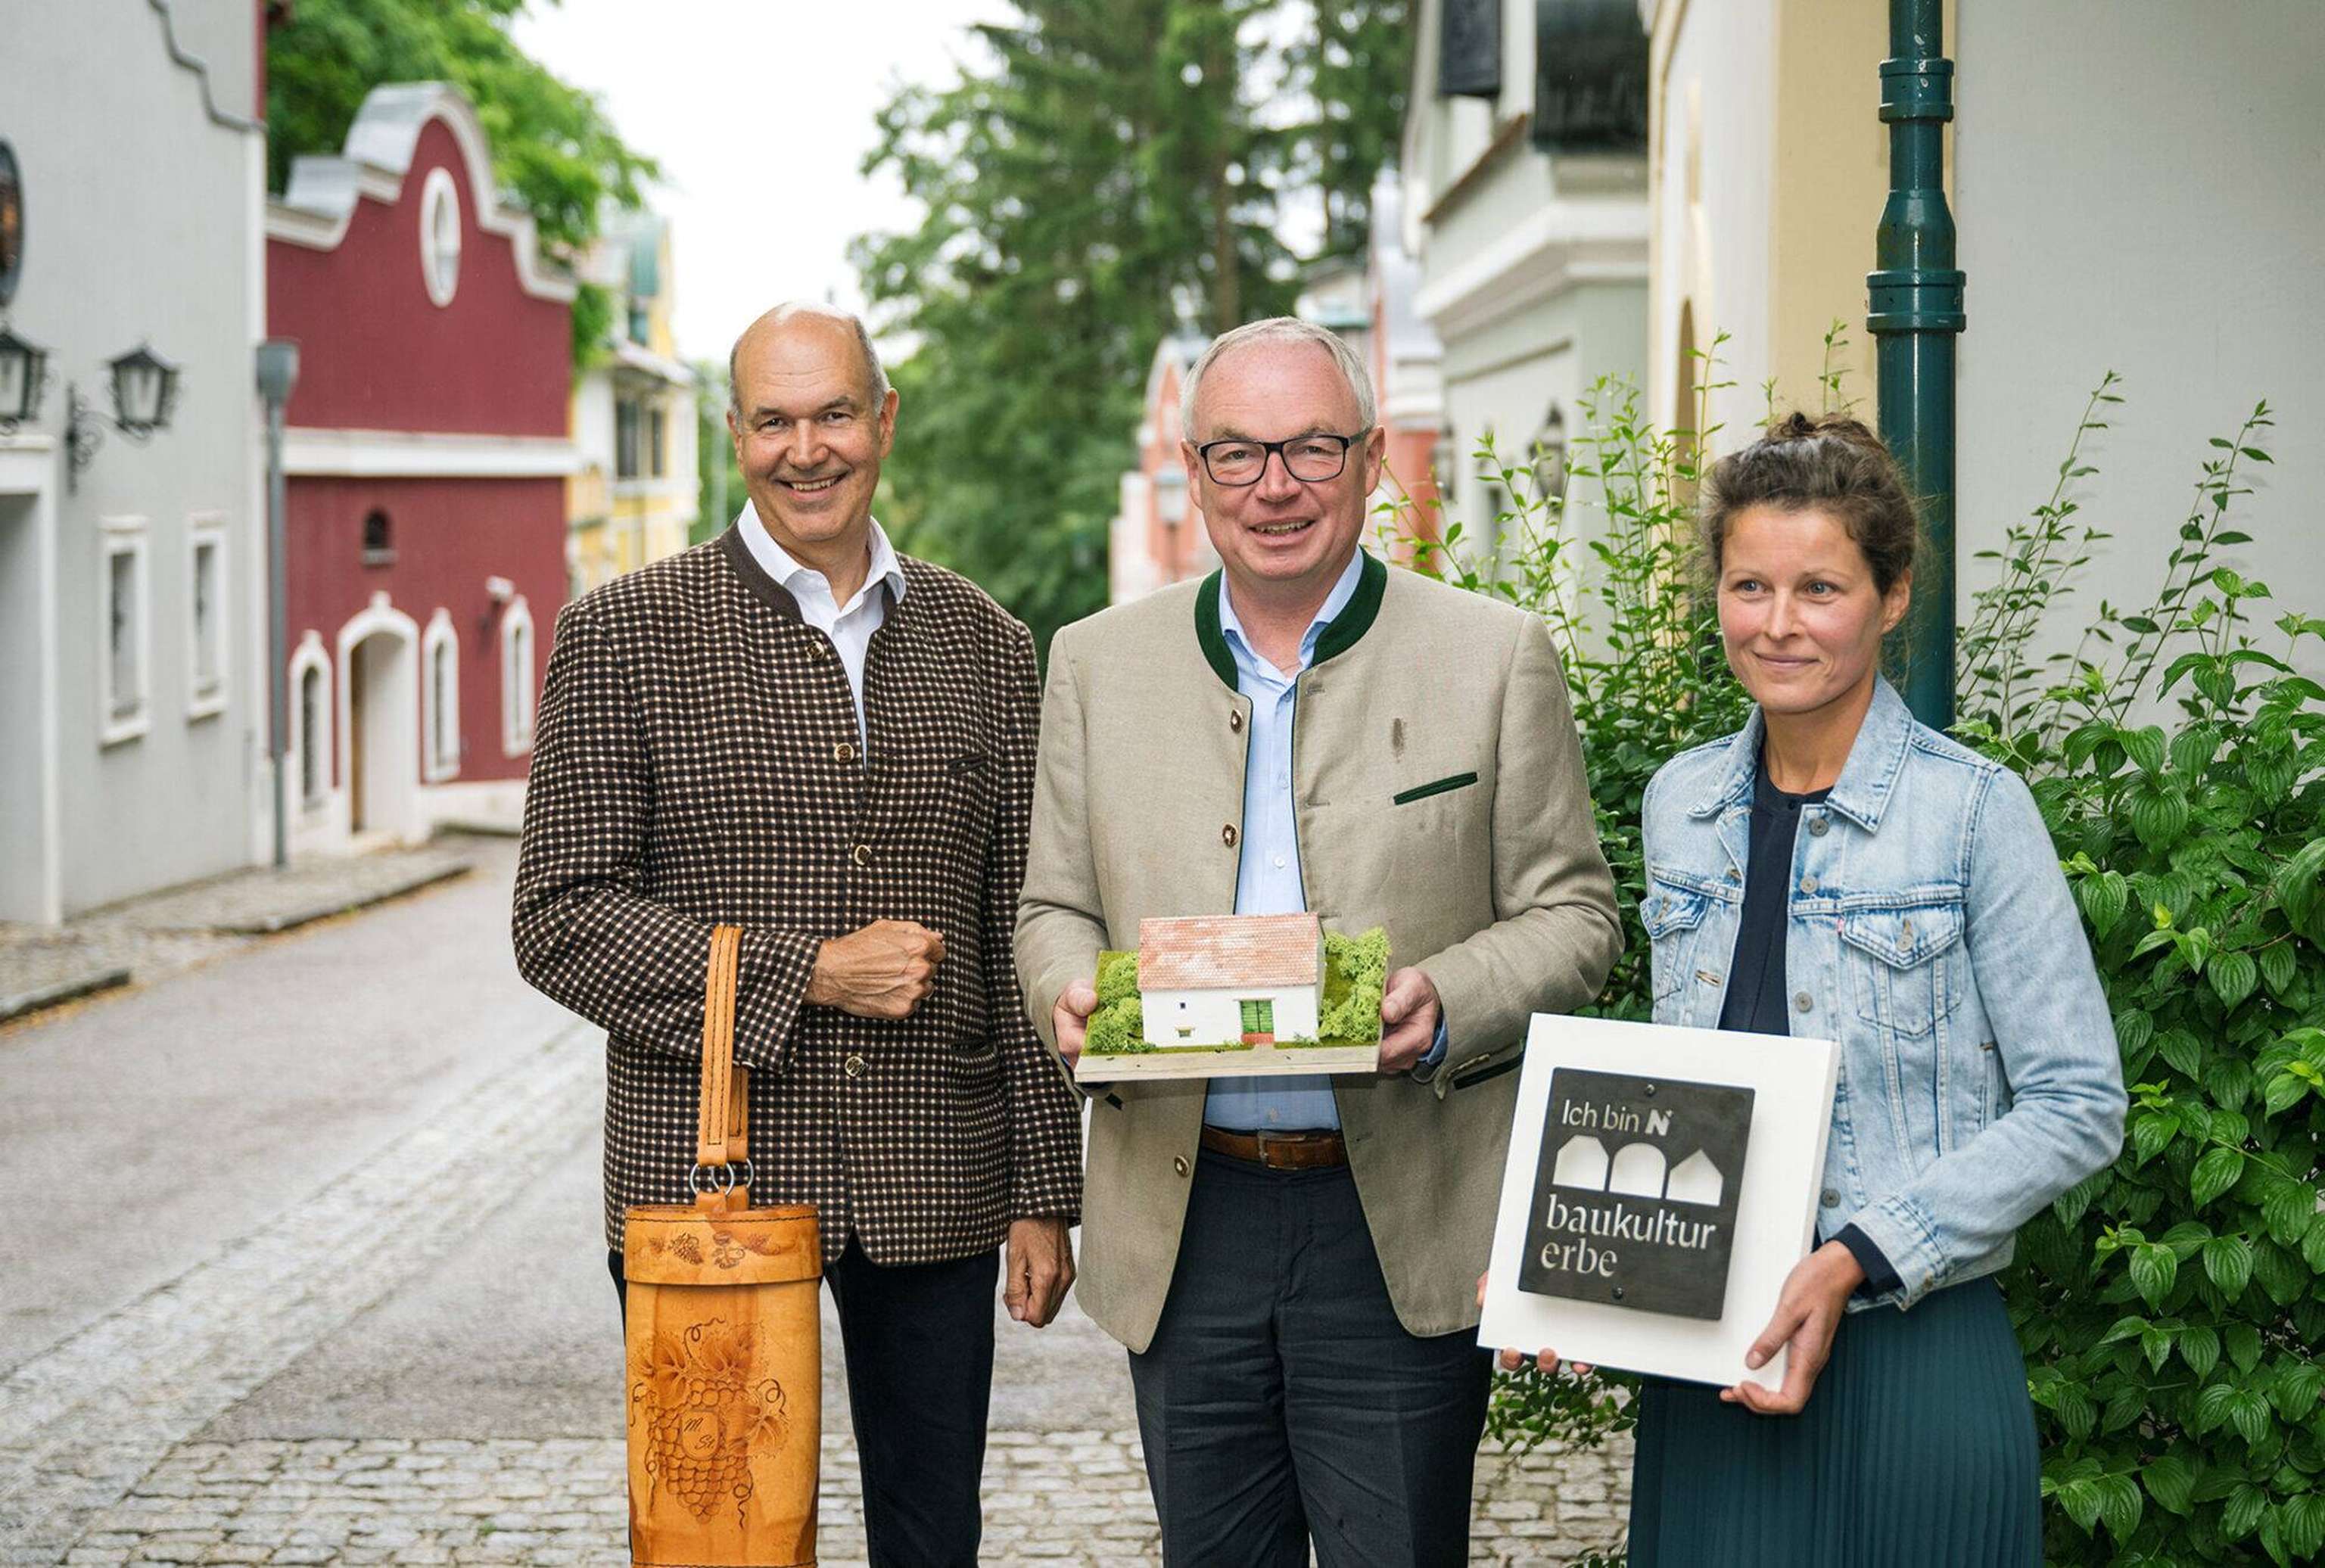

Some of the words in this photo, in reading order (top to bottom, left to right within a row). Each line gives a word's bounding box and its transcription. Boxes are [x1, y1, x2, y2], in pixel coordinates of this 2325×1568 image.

[1561, 1099, 1598, 1128] Ich
[1602, 1103, 1639, 1133] bin
[1546, 1193, 1717, 1249] baukultur
[1540, 1238, 1618, 1277] erbe
